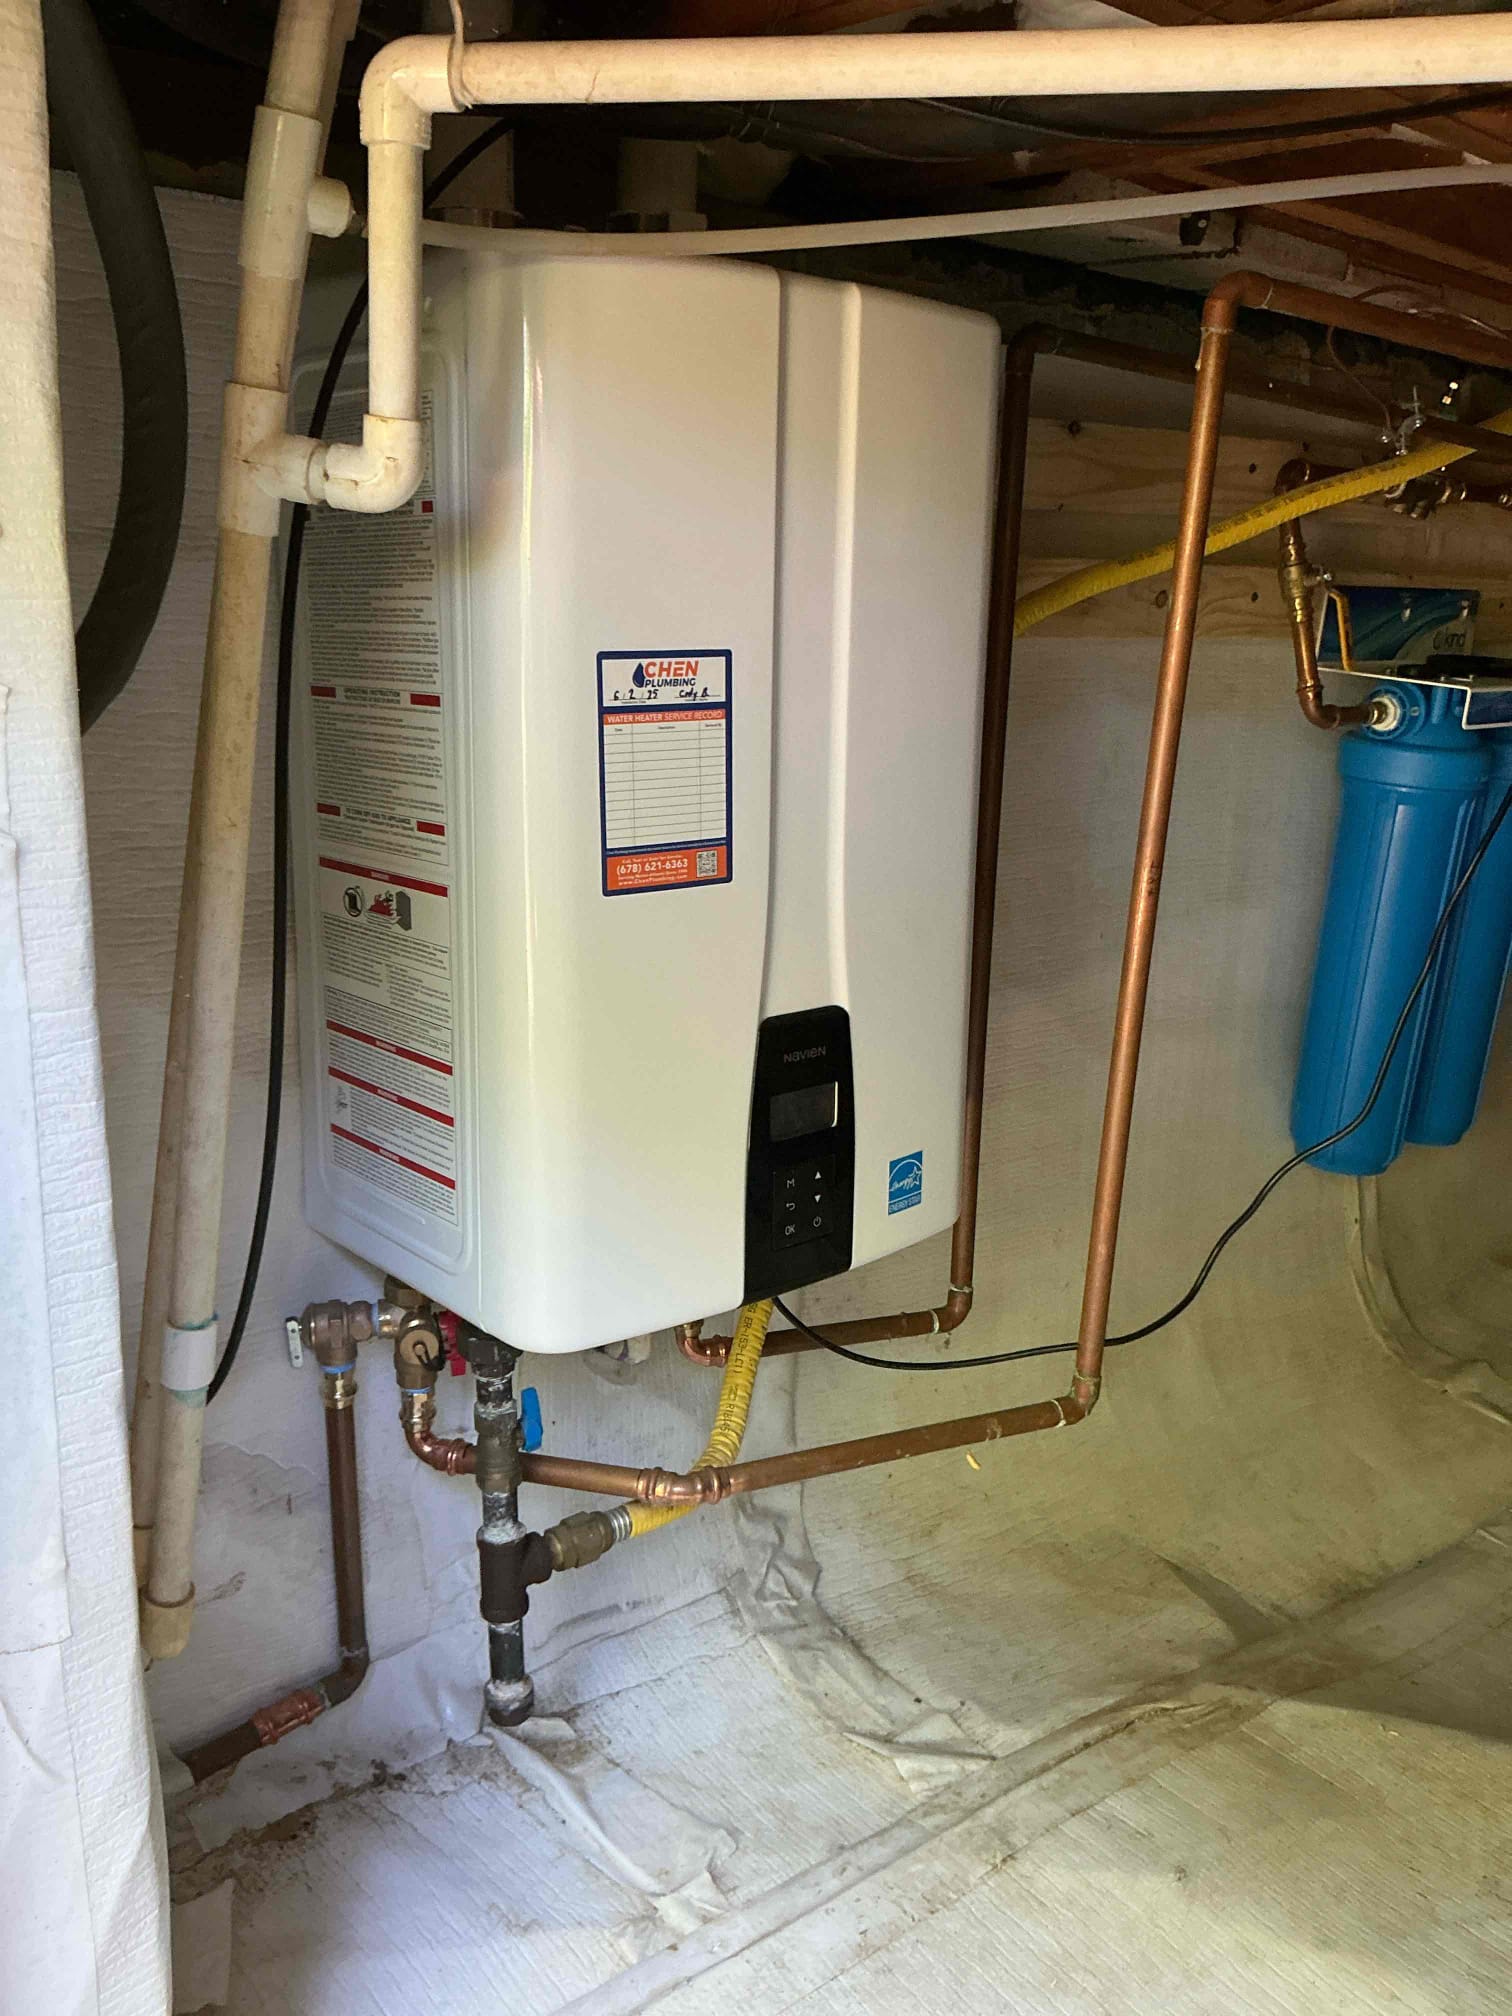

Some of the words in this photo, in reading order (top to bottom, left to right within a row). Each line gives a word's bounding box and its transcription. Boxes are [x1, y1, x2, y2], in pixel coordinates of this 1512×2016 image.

[644, 660, 699, 678] CHEN
[644, 678, 696, 688] PLUMBING
[607, 714, 633, 723] WATER
[634, 713, 662, 722] HEATER
[664, 711, 693, 721] SERVICE
[694, 710, 722, 719] RECORD
[616, 863, 642, 876] (678)
[644, 858, 689, 872] 621-6363
[786, 1178, 795, 1189] M
[784, 1224, 796, 1236] OK
